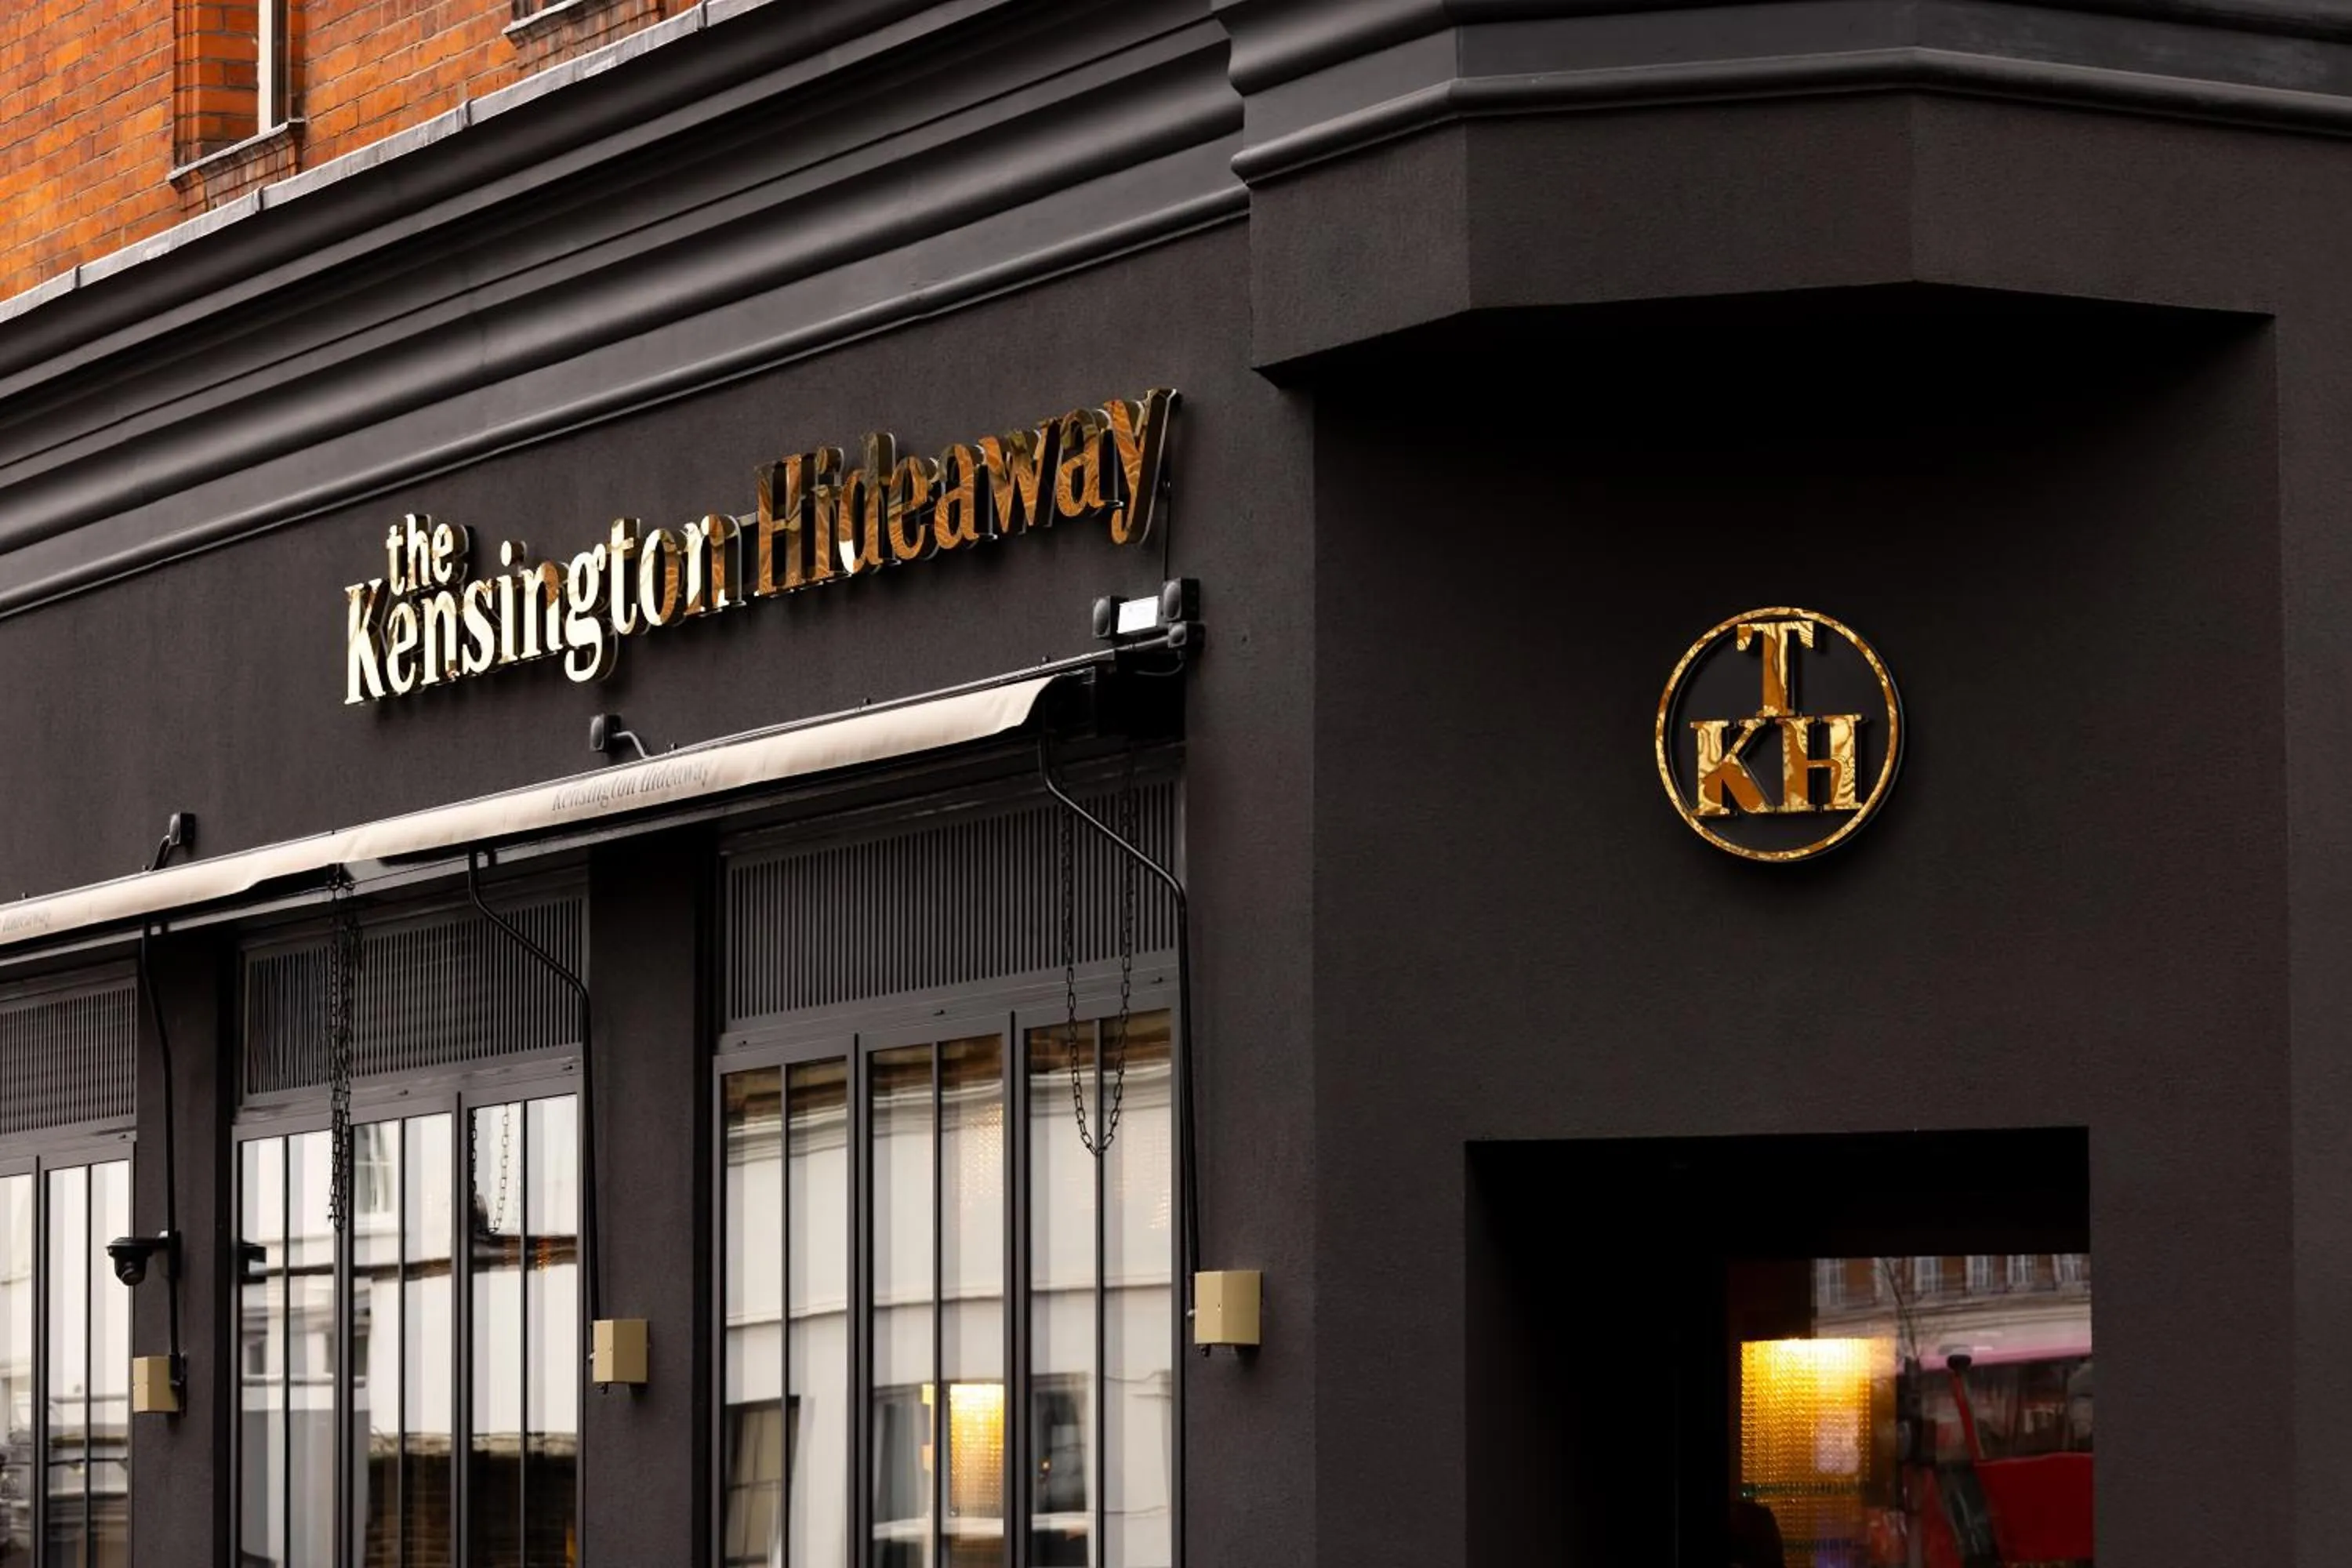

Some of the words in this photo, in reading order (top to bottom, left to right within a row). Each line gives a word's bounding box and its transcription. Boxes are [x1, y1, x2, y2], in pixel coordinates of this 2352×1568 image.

[344, 514, 742, 705] Kensington
[753, 388, 1176, 598] Hideaway
[386, 514, 463, 596] the
